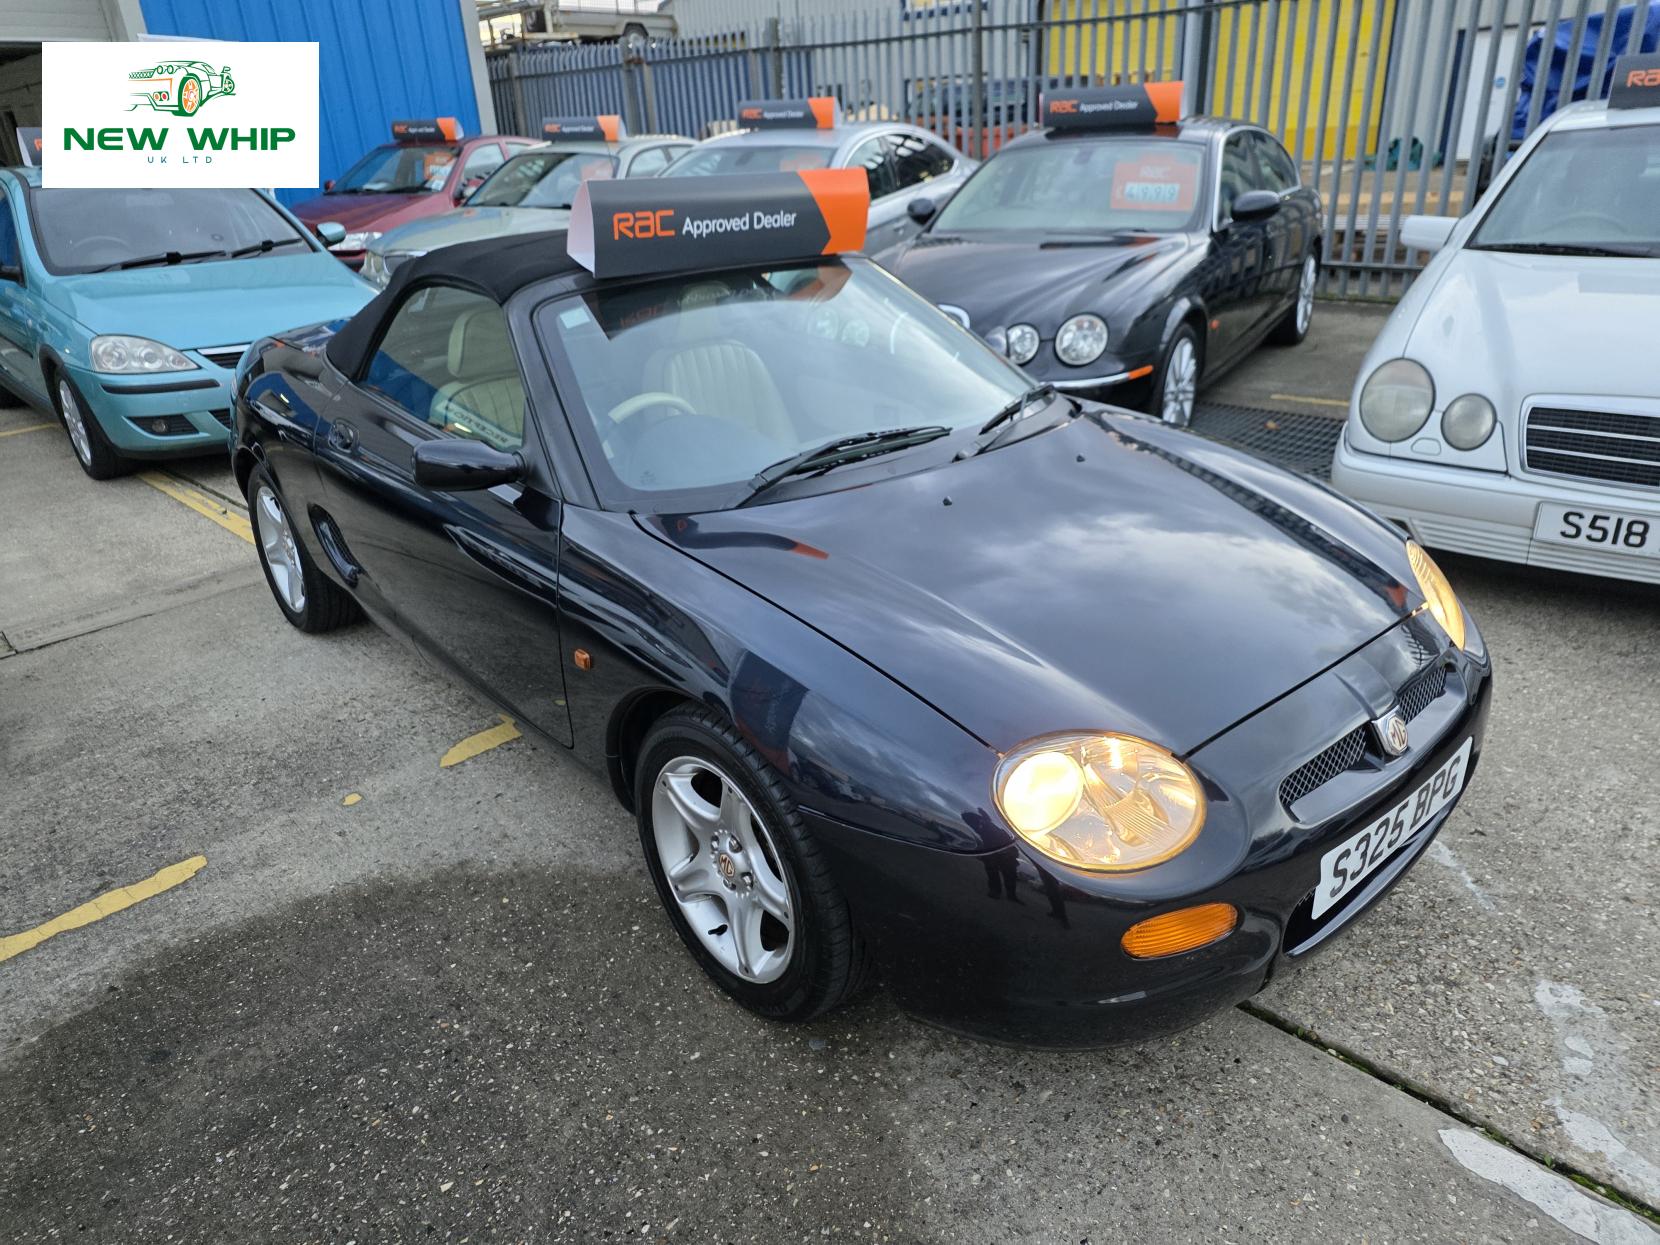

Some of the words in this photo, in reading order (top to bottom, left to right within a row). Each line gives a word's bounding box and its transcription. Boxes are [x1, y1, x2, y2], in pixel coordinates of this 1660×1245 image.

[1626, 68, 1660, 87] RA
[1080, 102, 1113, 113] Approved
[1114, 99, 1138, 111] Dealer
[682, 212, 750, 239] Approved
[753, 209, 797, 230] Dealer
[1560, 511, 1650, 548] S518
[1329, 799, 1410, 899] S325
[1409, 754, 1461, 831] BPG
[720, 855, 734, 875] MG
